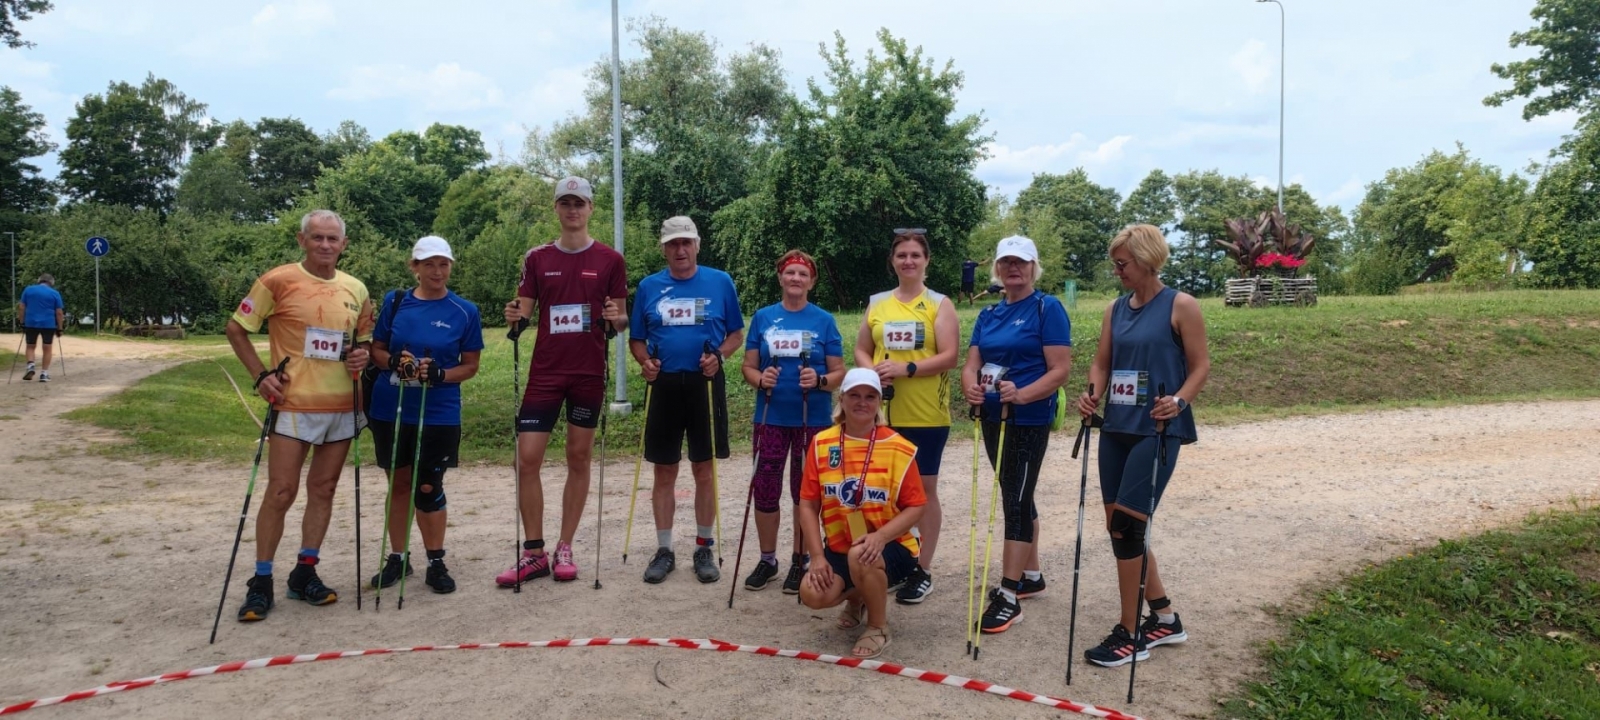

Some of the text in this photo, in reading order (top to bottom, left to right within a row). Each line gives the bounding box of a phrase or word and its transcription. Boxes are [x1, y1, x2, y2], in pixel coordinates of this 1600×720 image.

[668, 308, 691, 318] 121
[553, 315, 580, 326] 144
[887, 331, 913, 342] 132
[311, 339, 338, 352] 101
[773, 340, 799, 350] 120
[981, 374, 994, 385] 02
[1112, 383, 1134, 396] 142
[824, 486, 886, 501] IN WA
